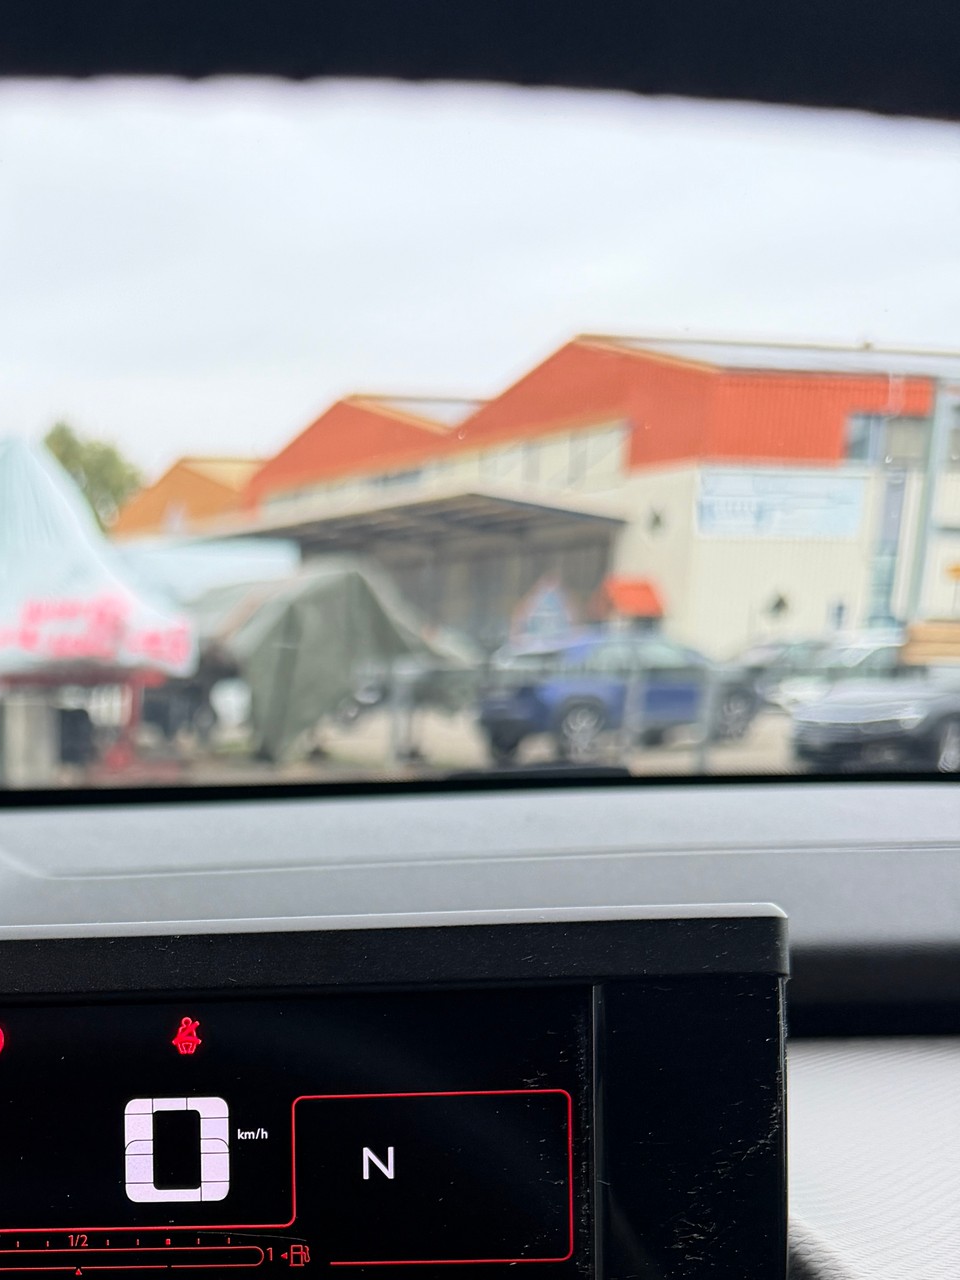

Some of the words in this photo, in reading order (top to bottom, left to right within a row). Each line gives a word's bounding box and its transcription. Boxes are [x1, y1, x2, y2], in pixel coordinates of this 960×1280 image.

[123, 1096, 230, 1203] 0
[237, 1128, 269, 1141] km/h
[362, 1146, 395, 1180] N
[68, 1234, 89, 1248] 1/2
[266, 1247, 274, 1262] 1
